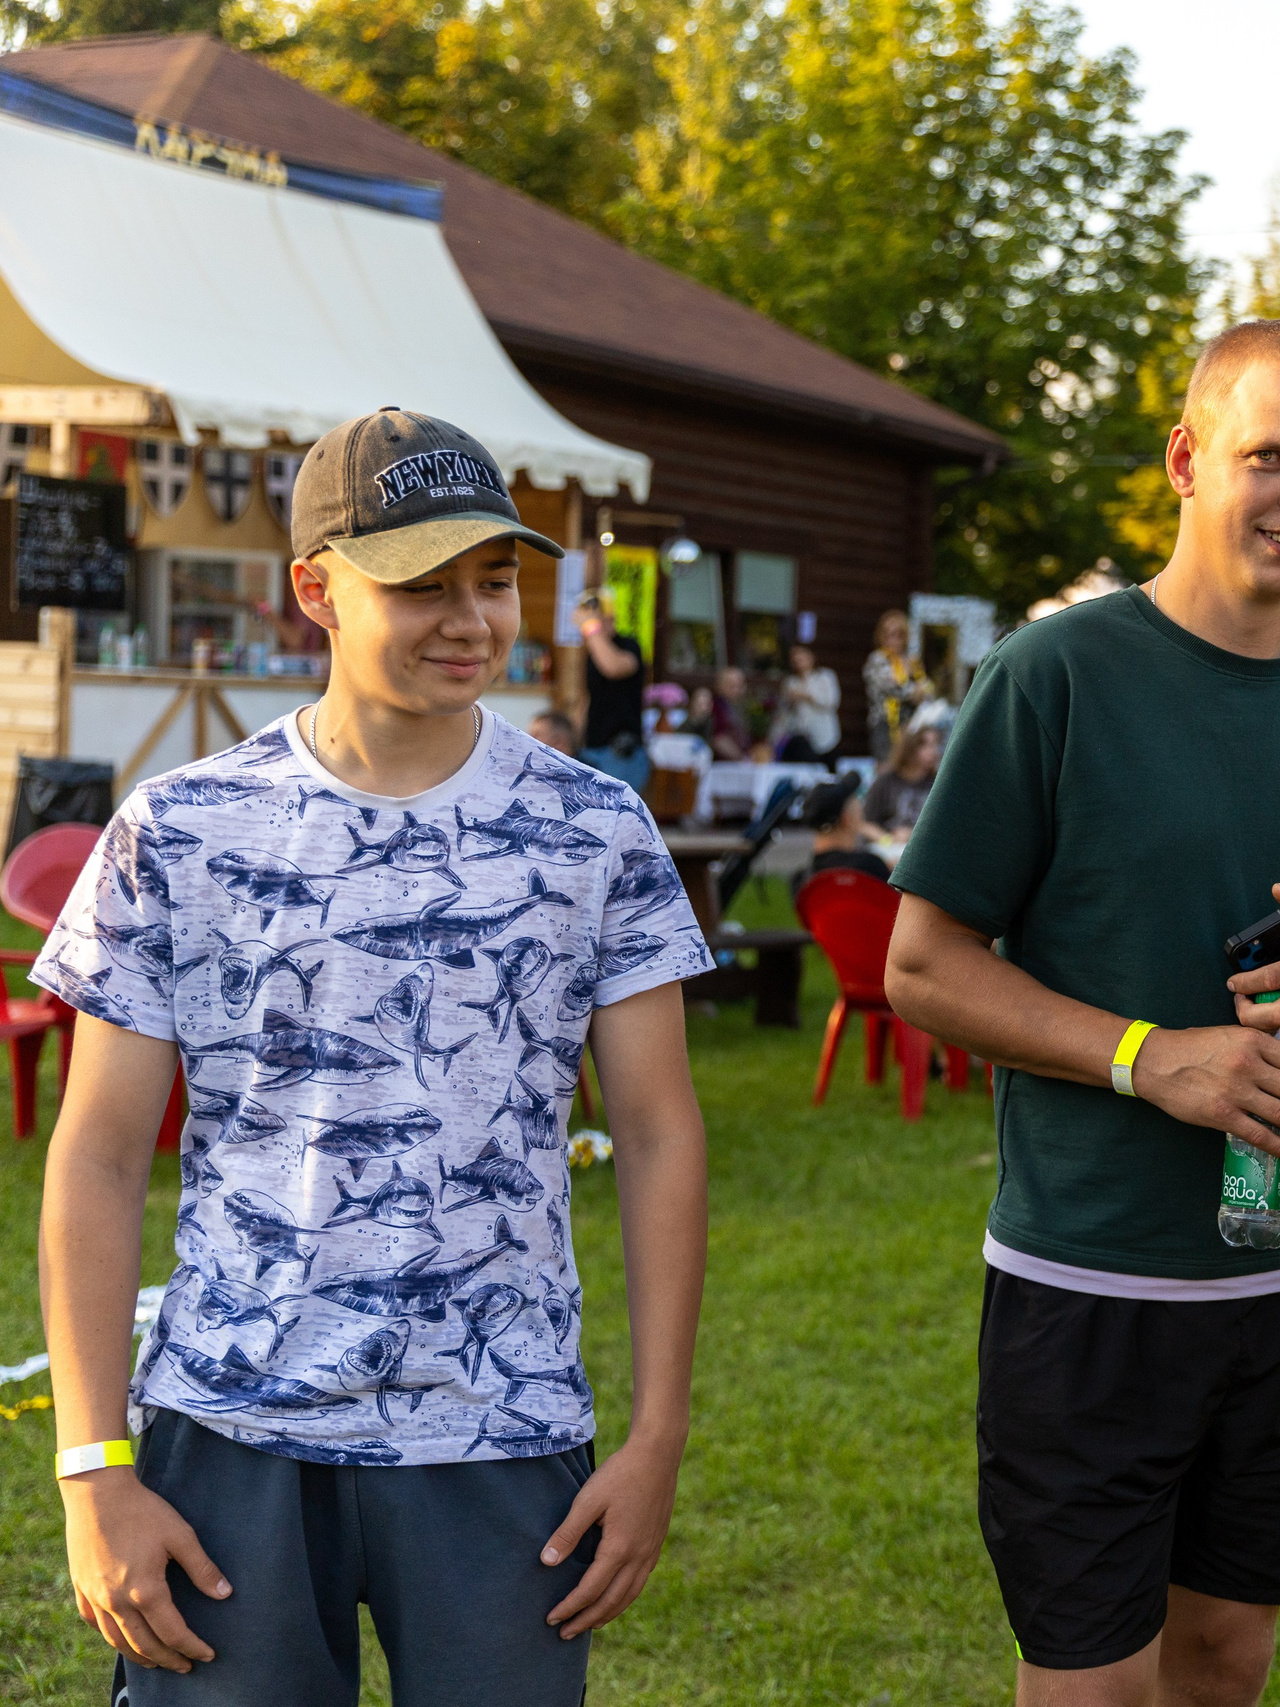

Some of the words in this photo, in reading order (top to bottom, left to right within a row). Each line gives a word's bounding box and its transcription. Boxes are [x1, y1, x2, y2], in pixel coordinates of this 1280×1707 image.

[374, 451, 440, 509] NEW
[436, 449, 507, 500] YORK
[1223, 1172, 1246, 1188] bon
[1223, 1185, 1256, 1200] aqua
